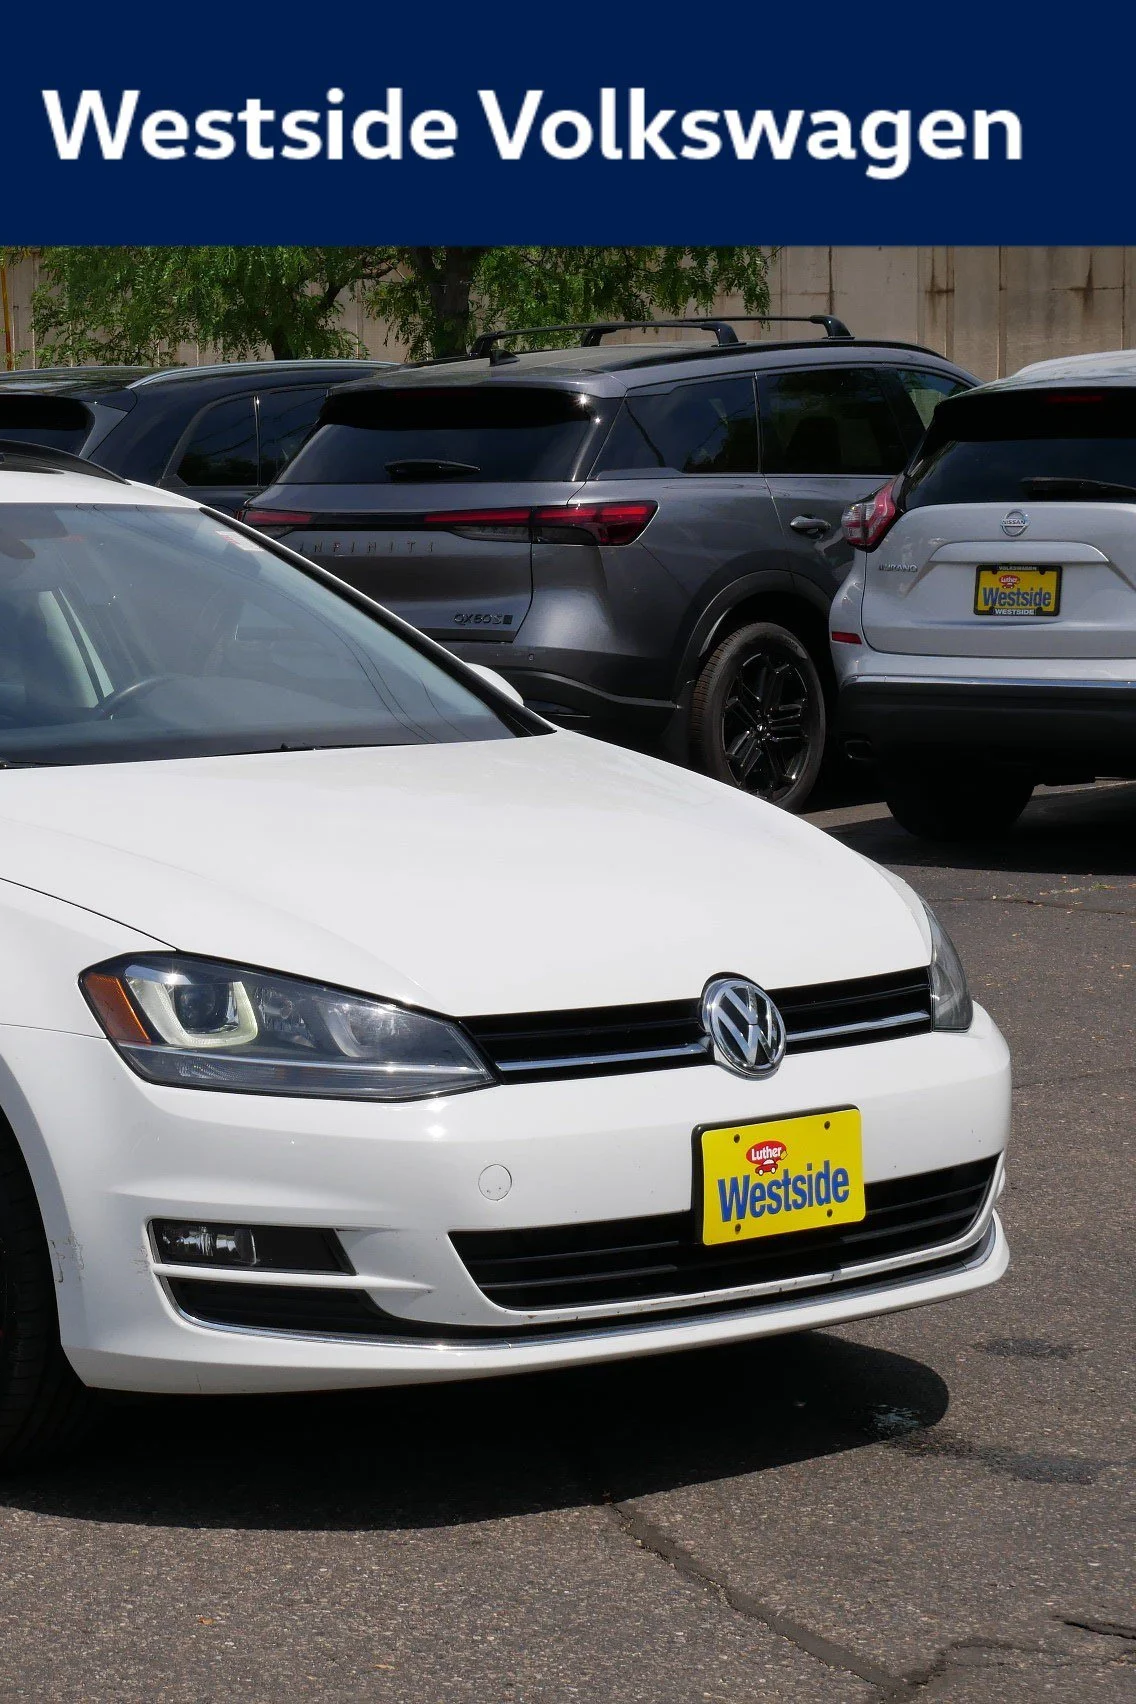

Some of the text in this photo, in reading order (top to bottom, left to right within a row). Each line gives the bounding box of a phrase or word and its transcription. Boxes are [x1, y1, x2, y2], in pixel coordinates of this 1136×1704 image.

[299, 541, 436, 553] INFINITI
[1000, 575, 1018, 583] Luther
[983, 586, 1052, 607] Westside
[750, 1145, 782, 1161] Luther
[717, 1160, 849, 1223] Westside
